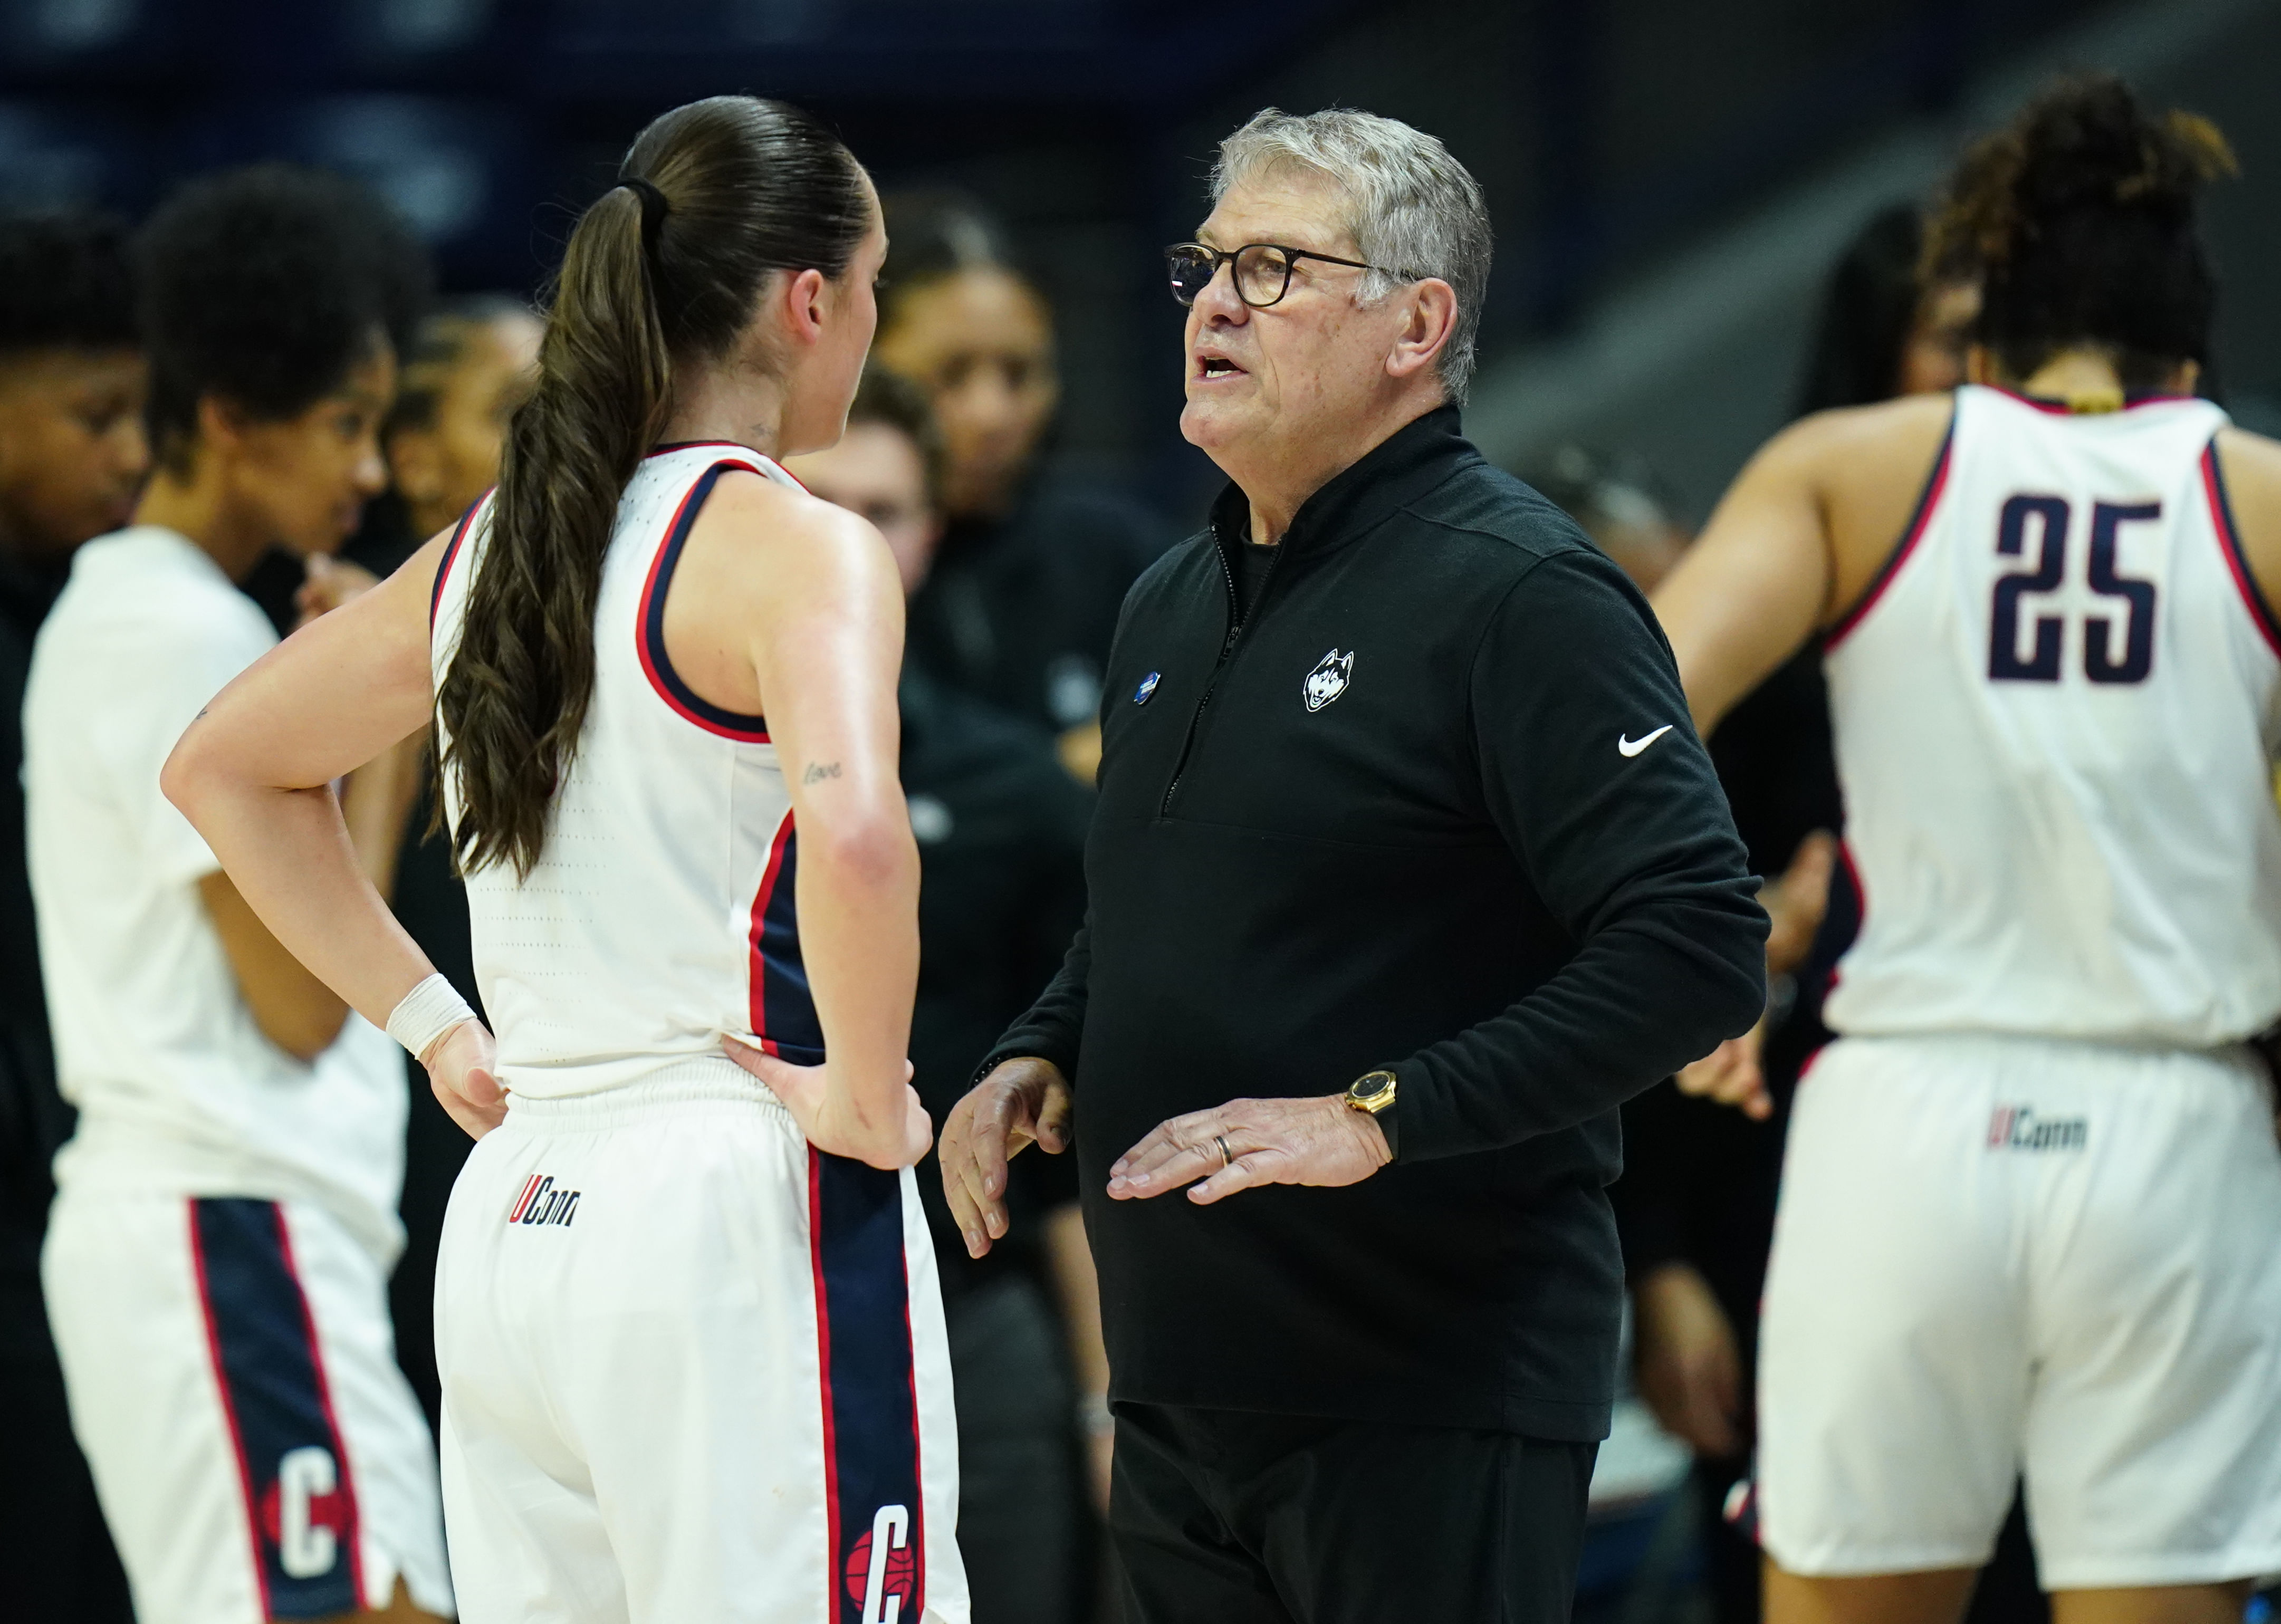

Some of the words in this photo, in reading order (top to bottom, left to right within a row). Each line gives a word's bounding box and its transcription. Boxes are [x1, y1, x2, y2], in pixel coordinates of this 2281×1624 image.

[1989, 494, 2162, 684] 25
[1987, 1107, 2088, 1148] UConn
[510, 1174, 581, 1227] UConn
[278, 1445, 337, 1579] C
[862, 1504, 908, 1624] C
